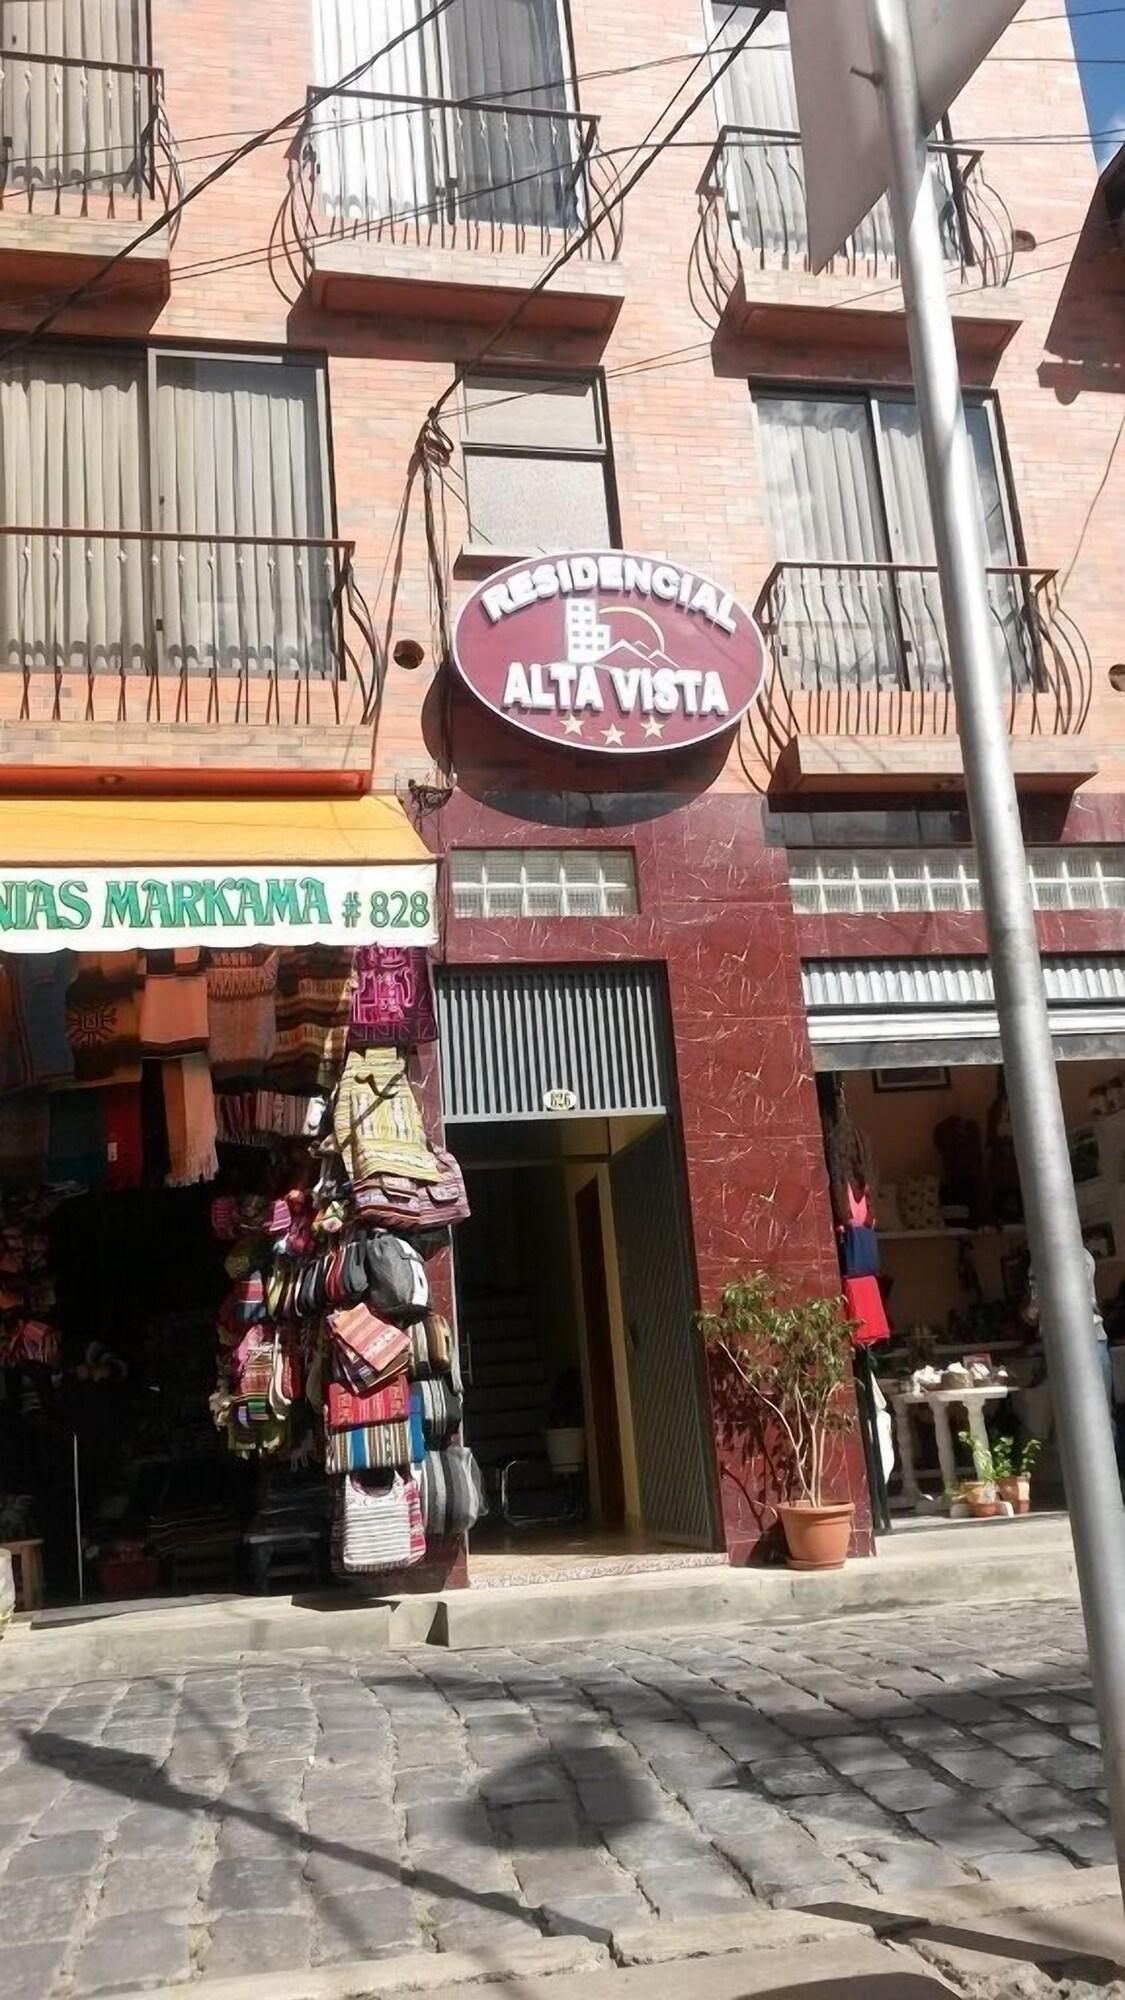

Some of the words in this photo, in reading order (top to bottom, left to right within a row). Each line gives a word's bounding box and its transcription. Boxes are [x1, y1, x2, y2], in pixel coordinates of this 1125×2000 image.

[481, 556, 736, 634] RESIDENCIAL
[503, 661, 604, 712] ALTA
[609, 667, 730, 716] VISTA
[102, 877, 332, 928] MARKAMA
